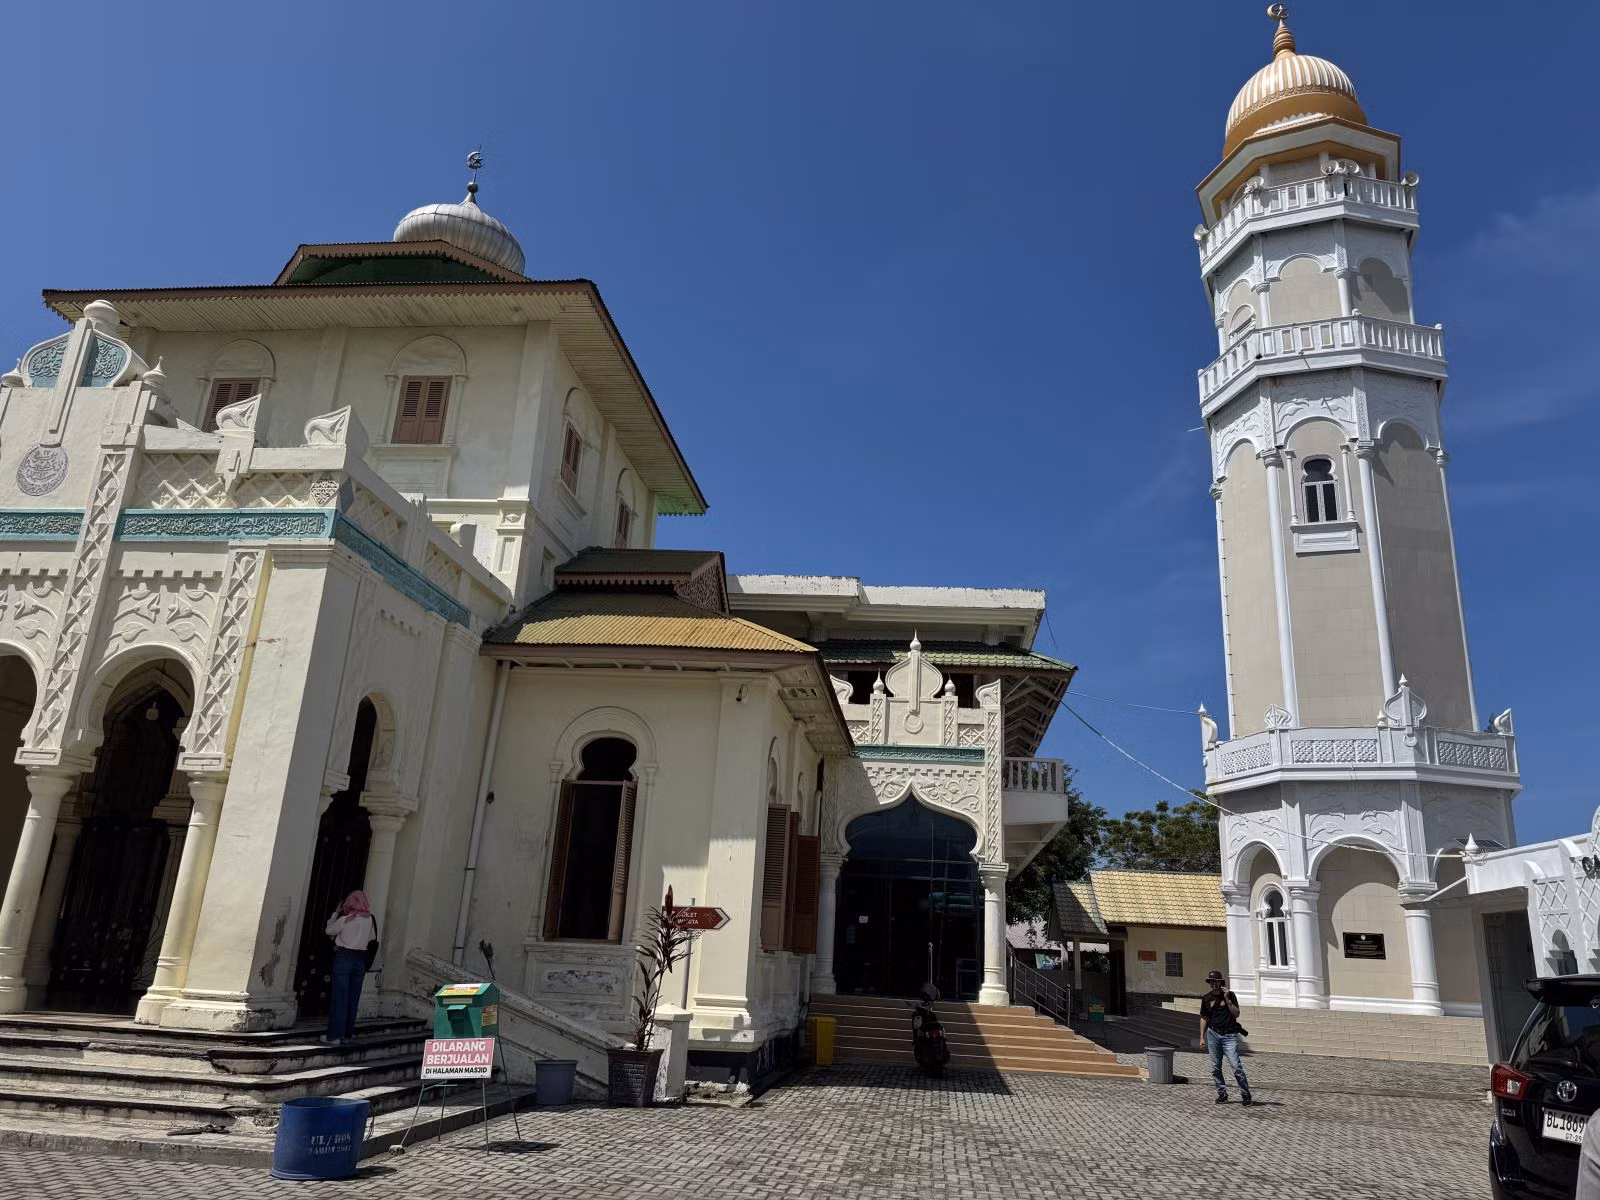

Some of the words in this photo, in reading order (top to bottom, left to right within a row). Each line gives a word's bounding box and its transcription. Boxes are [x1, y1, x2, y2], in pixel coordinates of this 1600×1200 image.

[432, 1041, 486, 1052] DILARANG
[427, 1053, 489, 1064] BERJUALAN
[1547, 1112, 1558, 1129] BL
